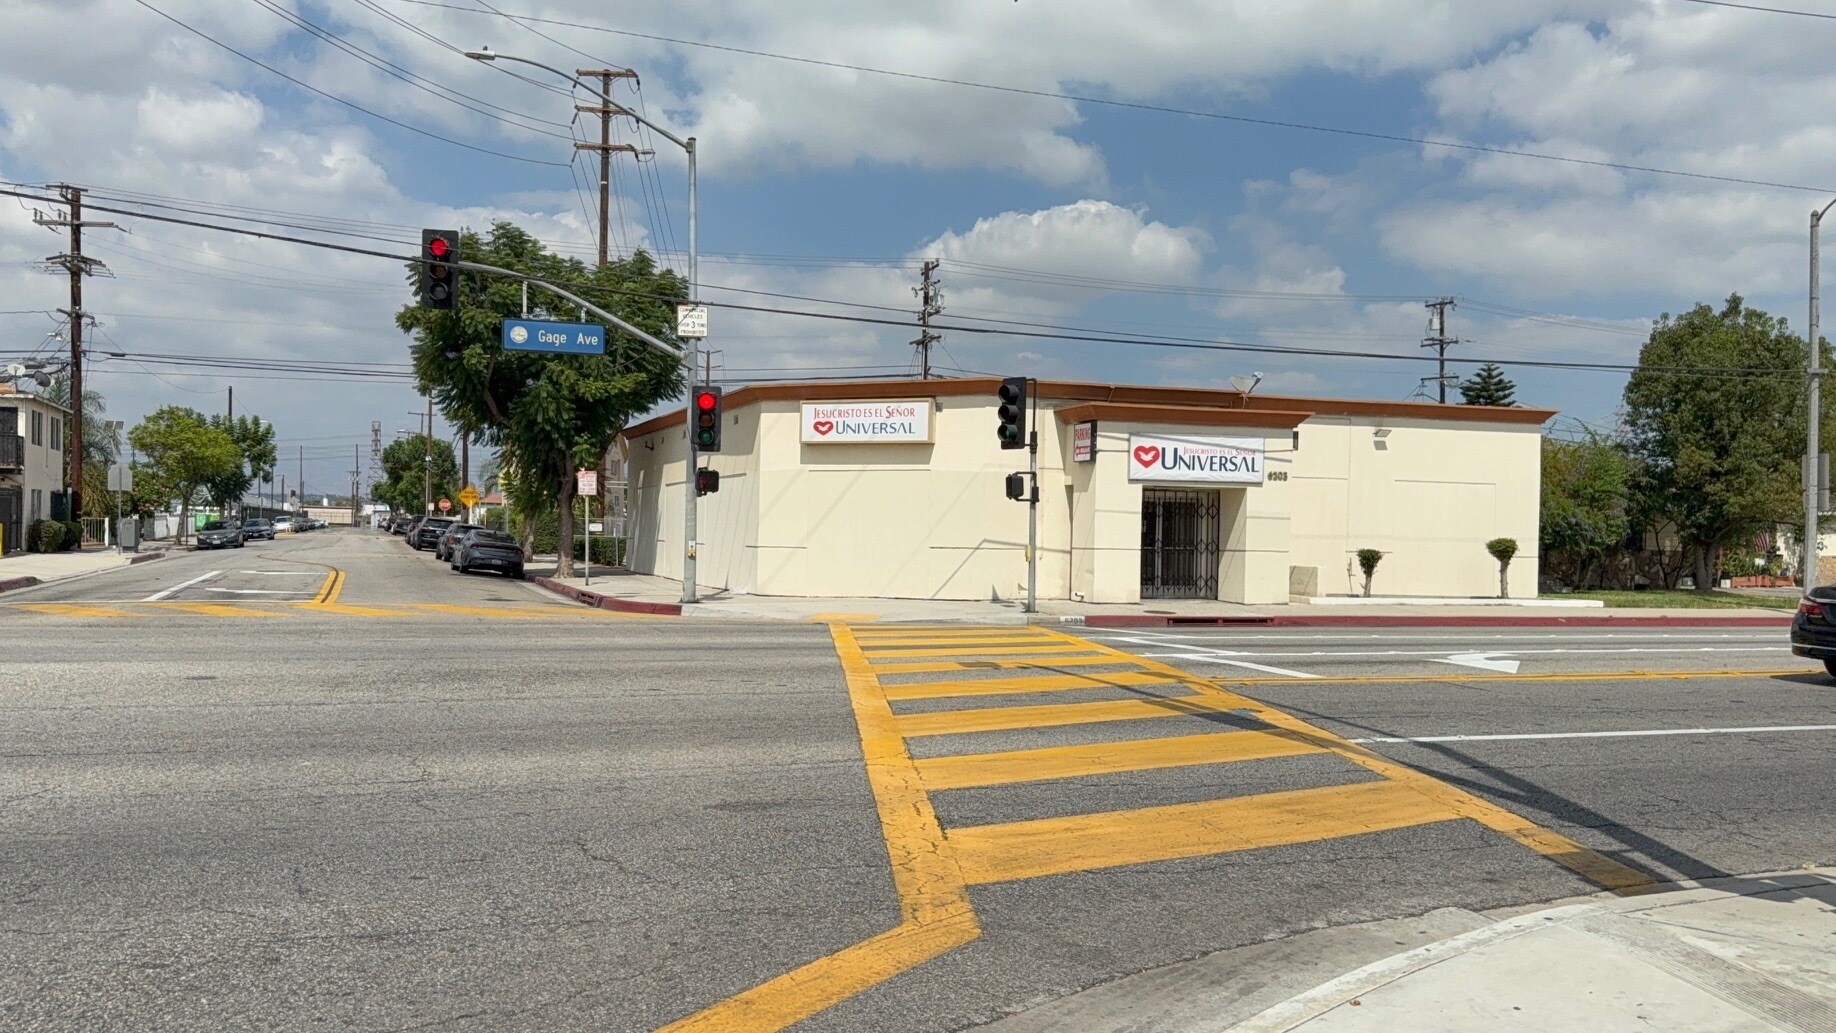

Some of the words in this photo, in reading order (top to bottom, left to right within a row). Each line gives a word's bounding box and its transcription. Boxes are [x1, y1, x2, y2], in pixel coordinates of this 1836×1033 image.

[691, 321, 696, 329] 3
[538, 329, 567, 347] Gage
[577, 332, 598, 345] Ave
[863, 408, 873, 418] ES
[874, 408, 884, 417] EL
[835, 420, 915, 435] UNIVERSAL
[1161, 446, 1260, 473] UNIVERSAL
